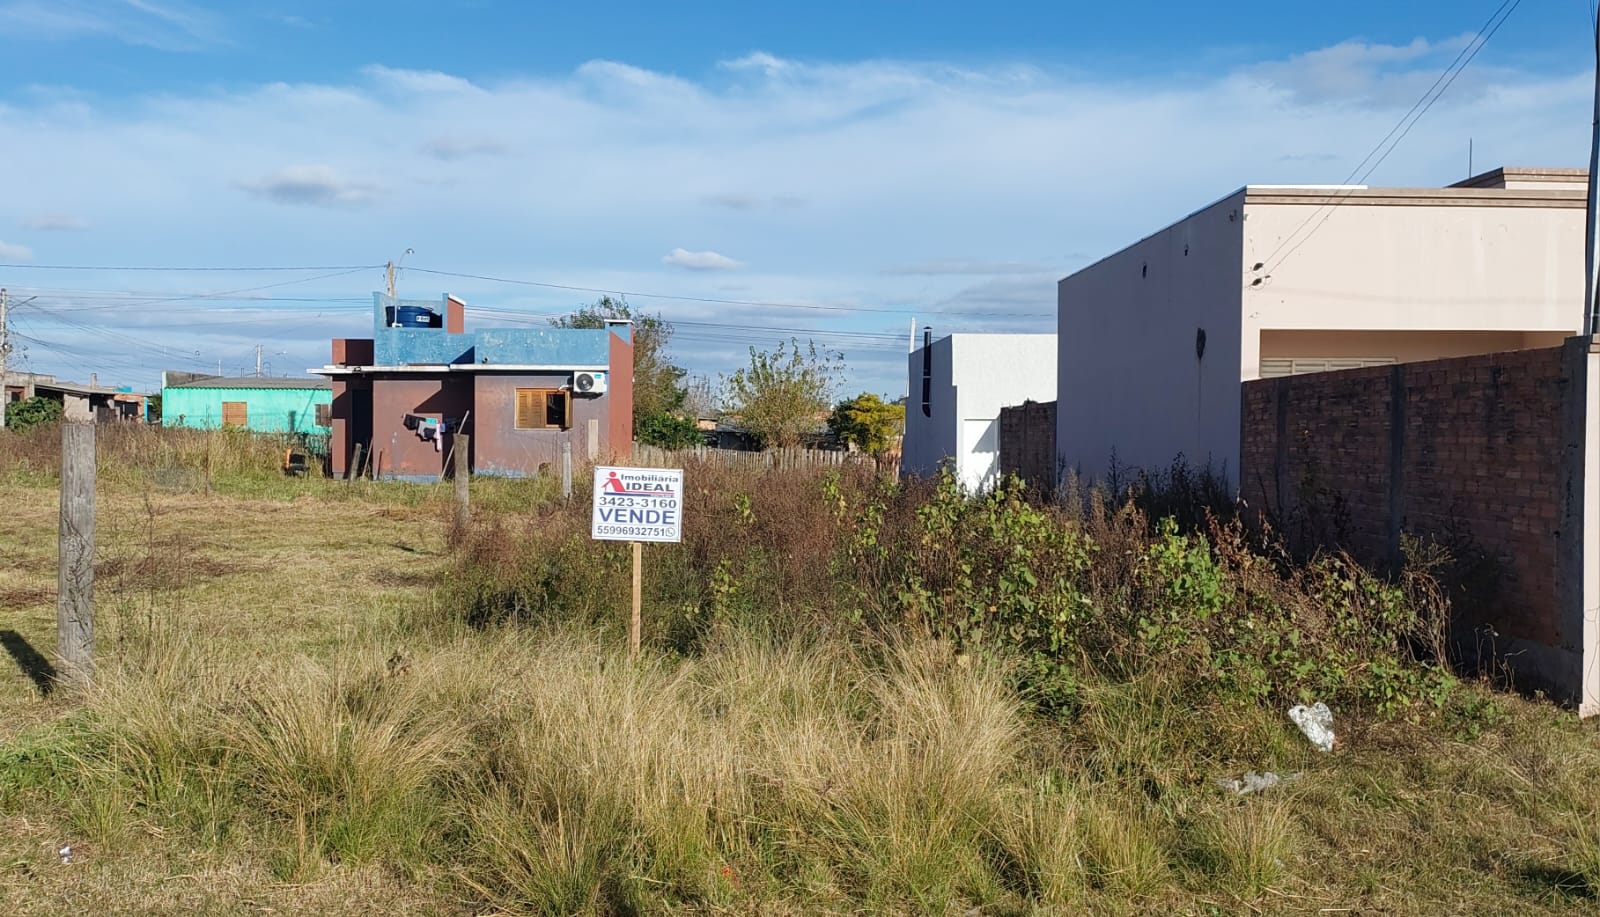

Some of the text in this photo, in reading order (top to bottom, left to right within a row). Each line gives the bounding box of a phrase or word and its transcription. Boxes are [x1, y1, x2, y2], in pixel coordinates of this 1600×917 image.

[626, 482, 675, 492] IDEAL
[599, 496, 677, 509] 3423-3160
[599, 508, 675, 525] VENDE
[597, 525, 665, 537] 55996932751
